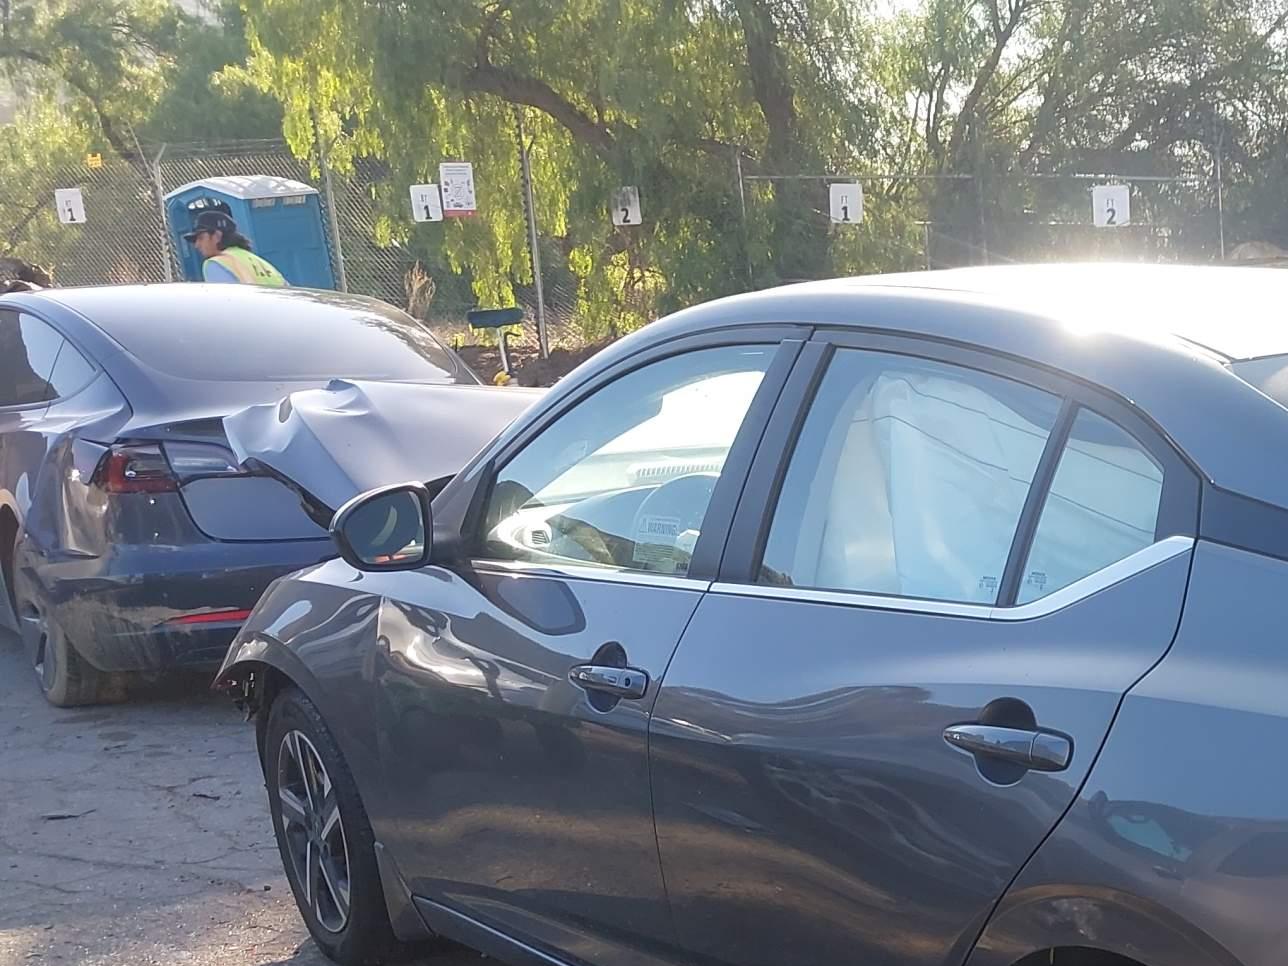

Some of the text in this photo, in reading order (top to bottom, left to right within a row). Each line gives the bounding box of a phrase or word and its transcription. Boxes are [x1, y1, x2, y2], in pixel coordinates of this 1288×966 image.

[67, 208, 76, 222] 1
[423, 205, 433, 220] 1
[621, 207, 631, 224] 2
[841, 205, 850, 221] 1
[1106, 208, 1117, 225] 2
